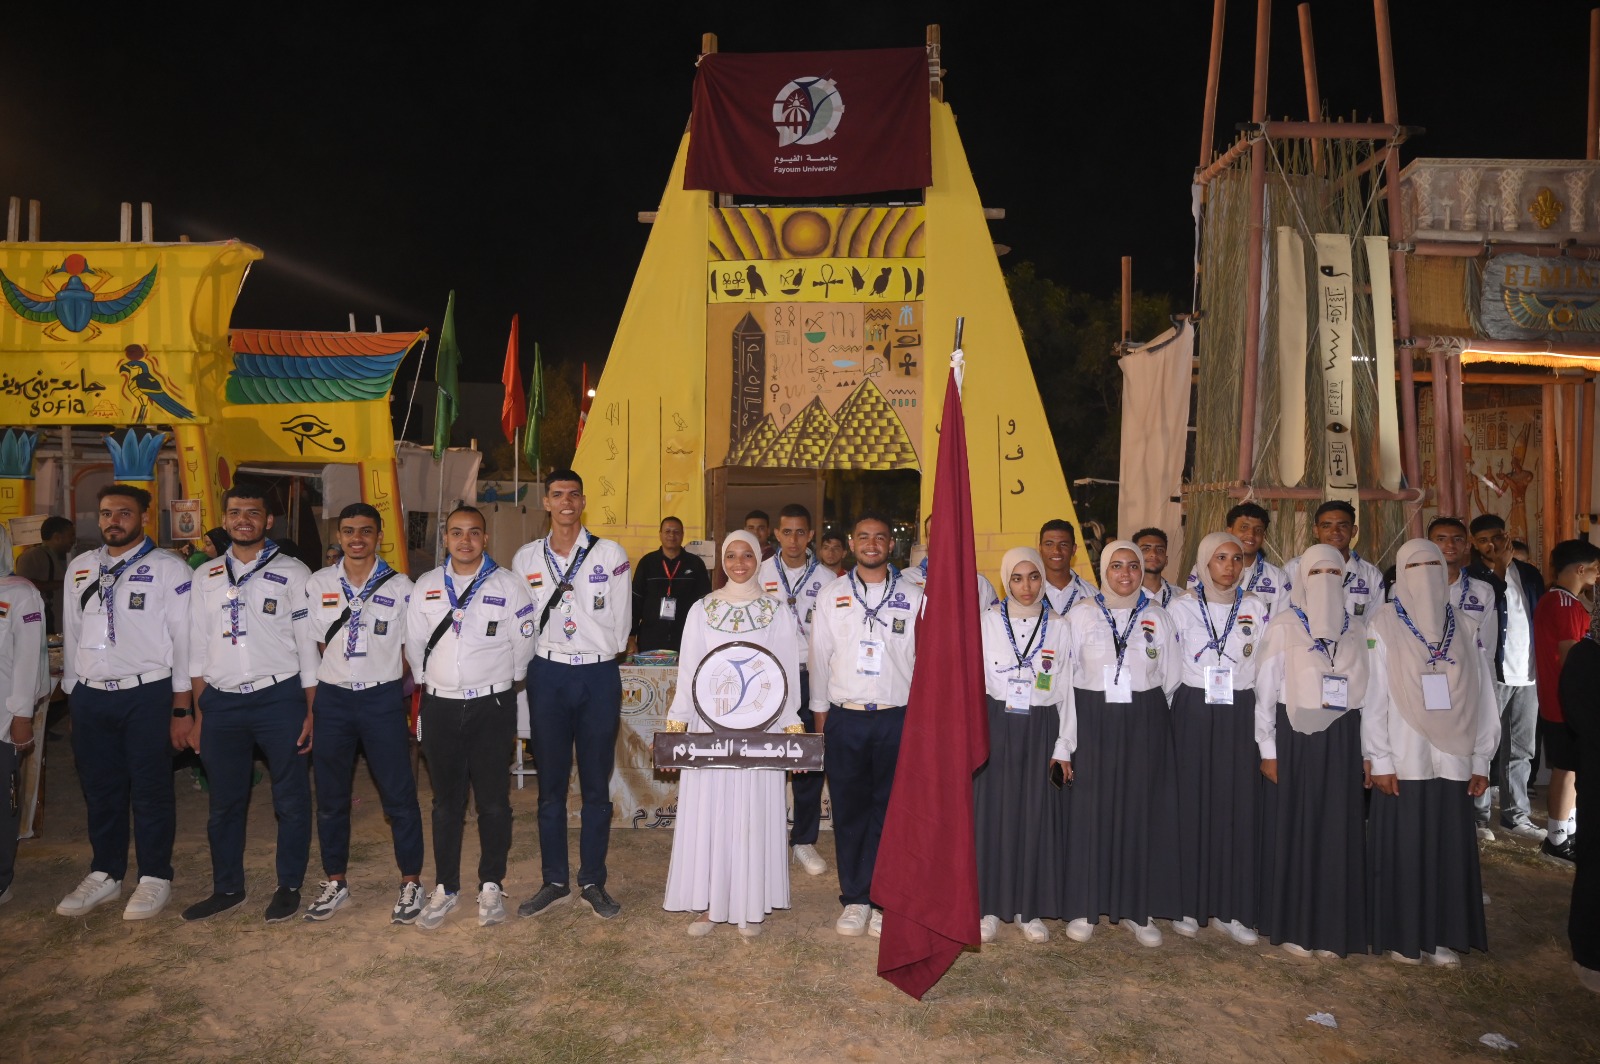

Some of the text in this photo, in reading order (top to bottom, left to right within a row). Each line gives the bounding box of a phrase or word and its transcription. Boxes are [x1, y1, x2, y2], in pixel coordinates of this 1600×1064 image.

[774, 154, 838, 164] جامعة الفيوم
[773, 165, 837, 174] Fayoum University
[1504, 264, 1600, 289] ELMIN
[672, 738, 804, 763] جامعة الفيوم
